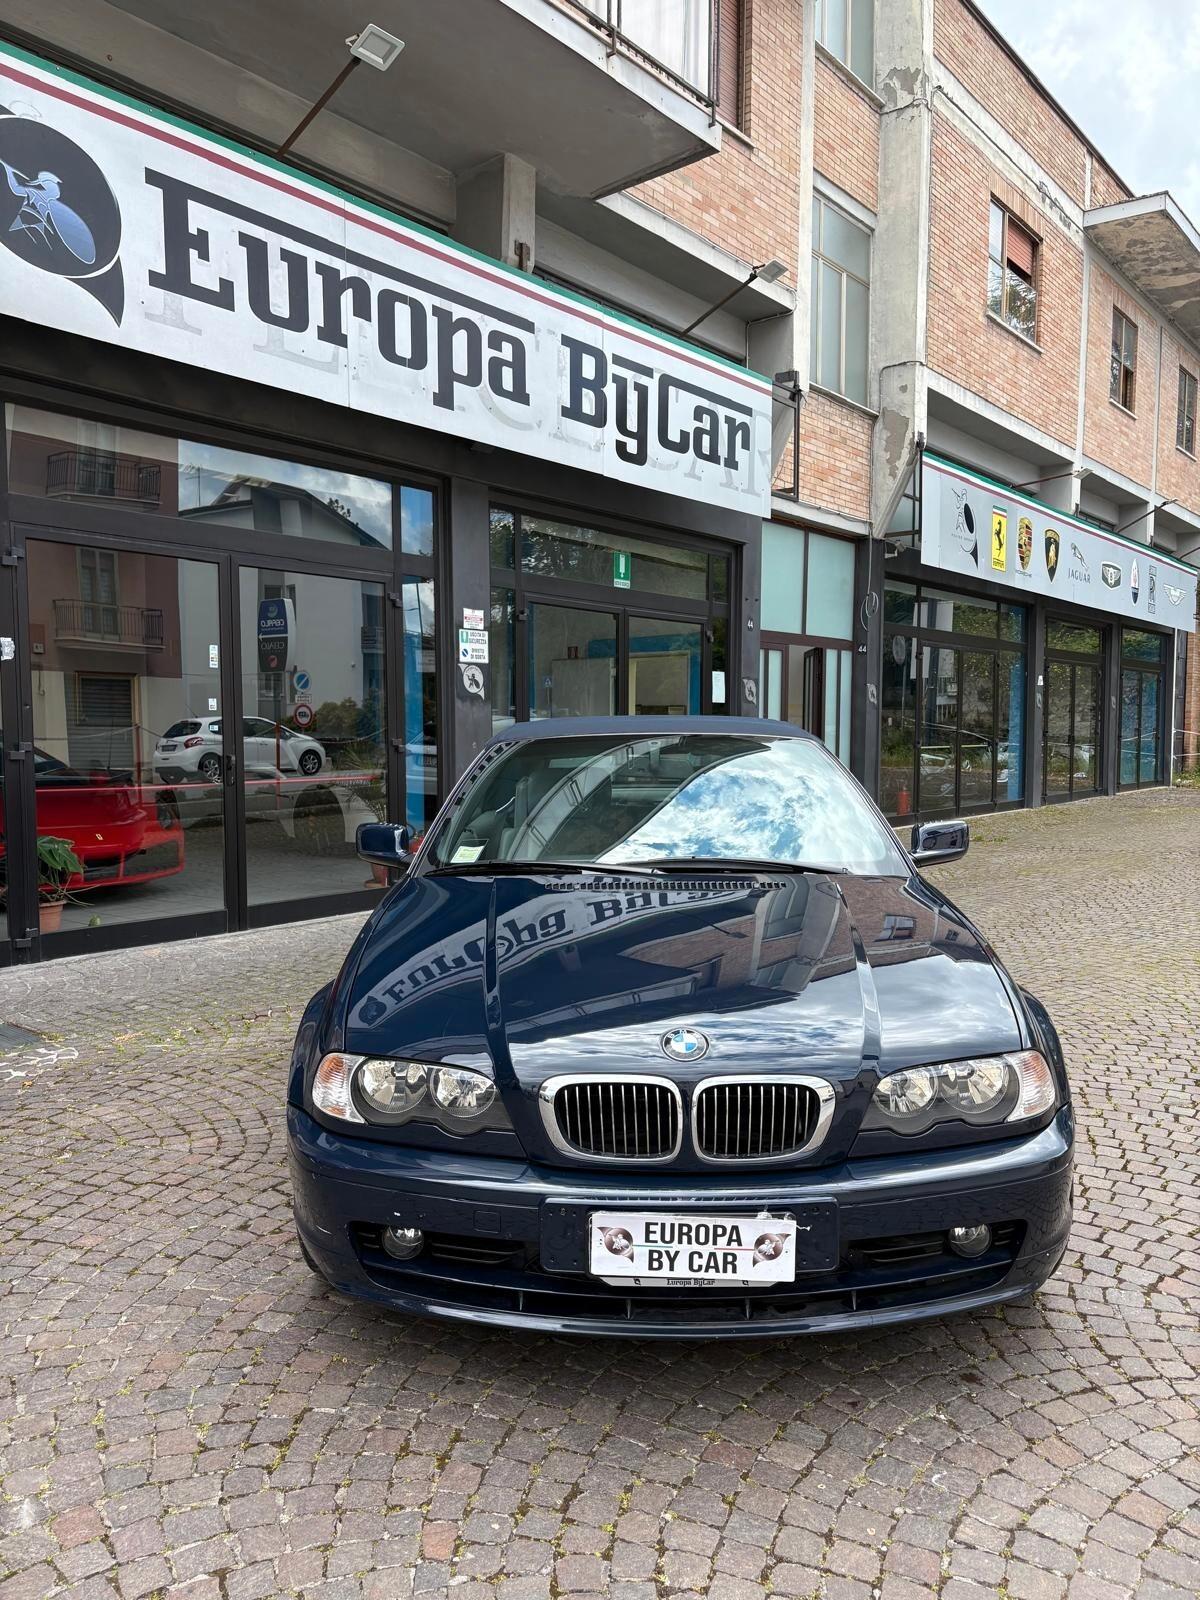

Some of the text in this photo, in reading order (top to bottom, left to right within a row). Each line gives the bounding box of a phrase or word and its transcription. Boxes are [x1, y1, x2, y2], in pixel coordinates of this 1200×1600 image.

[145, 167, 753, 471] Europa ByCar
[1068, 568, 1091, 584] JAGUAR
[858, 644, 867, 652] 44
[644, 1221, 743, 1247] EUROPA
[648, 1249, 738, 1274] BY CAR
[666, 1278, 692, 1286] Europa
